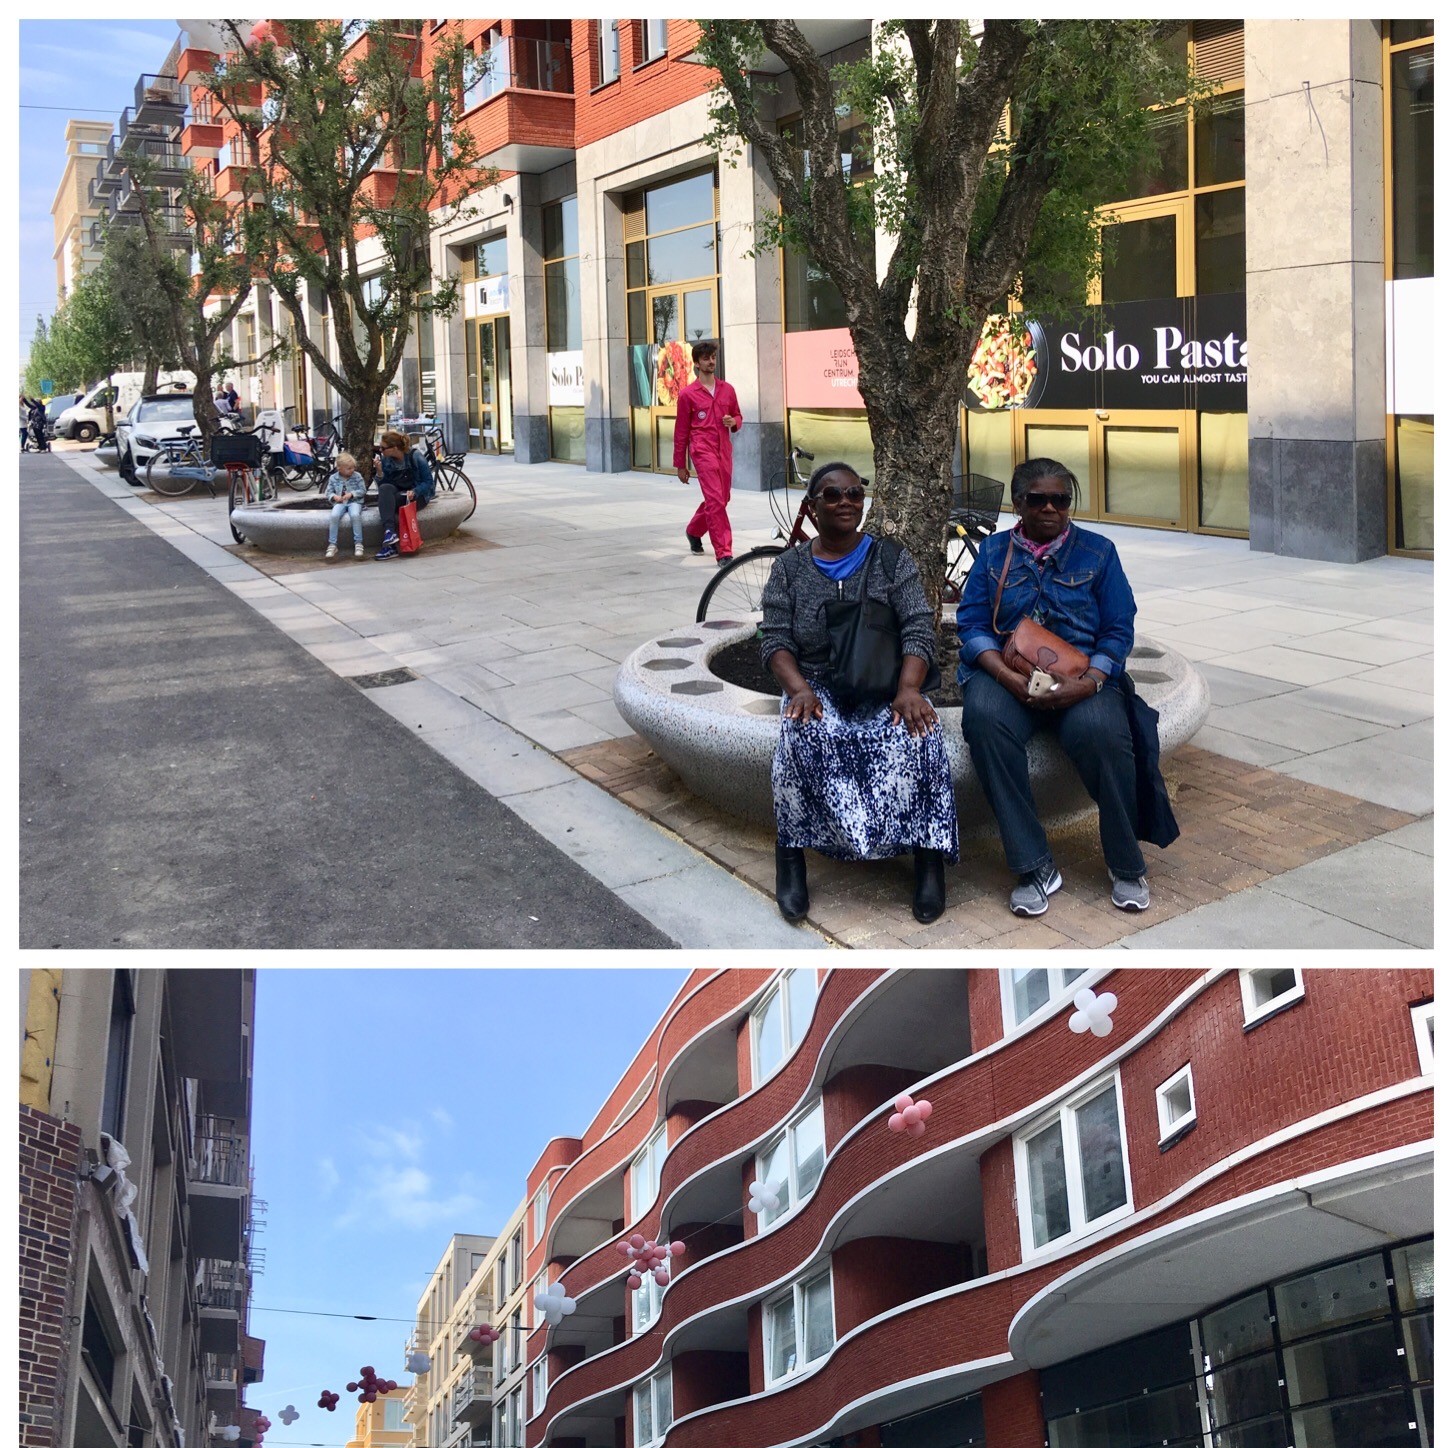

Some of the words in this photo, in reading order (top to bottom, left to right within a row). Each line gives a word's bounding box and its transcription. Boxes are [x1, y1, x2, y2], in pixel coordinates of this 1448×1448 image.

[830, 349, 857, 359] LEIDSCH
[1060, 331, 1140, 373] Solo
[552, 366, 572, 386] Solo
[1141, 375, 1159, 384] YOU
[1162, 375, 1180, 383] CAN
[1183, 374, 1222, 383] ALMOST
[1224, 372, 1247, 382] TAST
[831, 378, 859, 388] UTRECH
